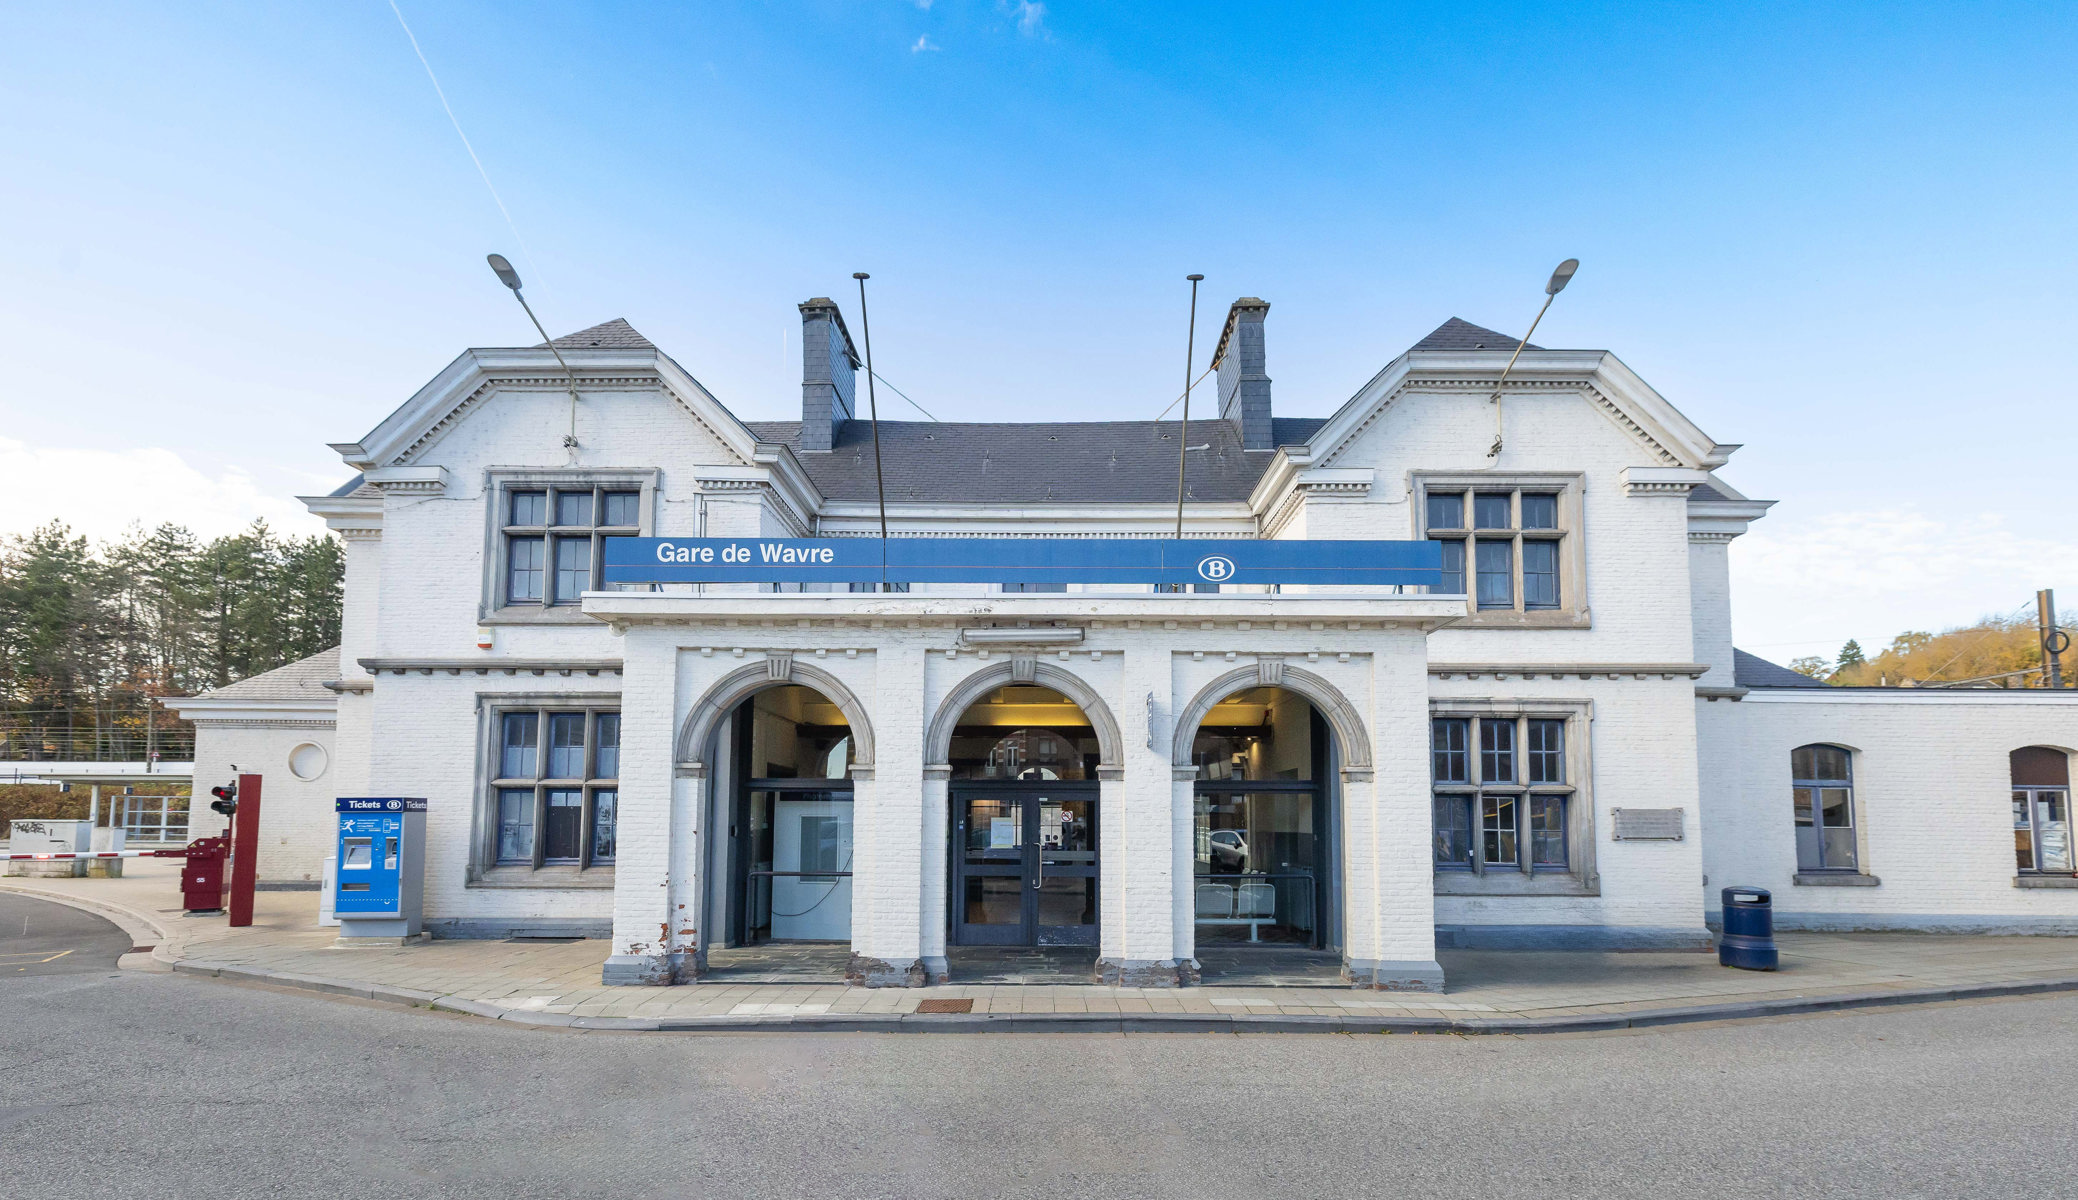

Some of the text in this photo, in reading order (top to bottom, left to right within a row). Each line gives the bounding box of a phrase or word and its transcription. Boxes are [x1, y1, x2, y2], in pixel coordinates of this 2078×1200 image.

[656, 542, 834, 563] Gare de Wavre
[348, 800, 381, 809] Tickets
[406, 800, 427, 809] Tickets
